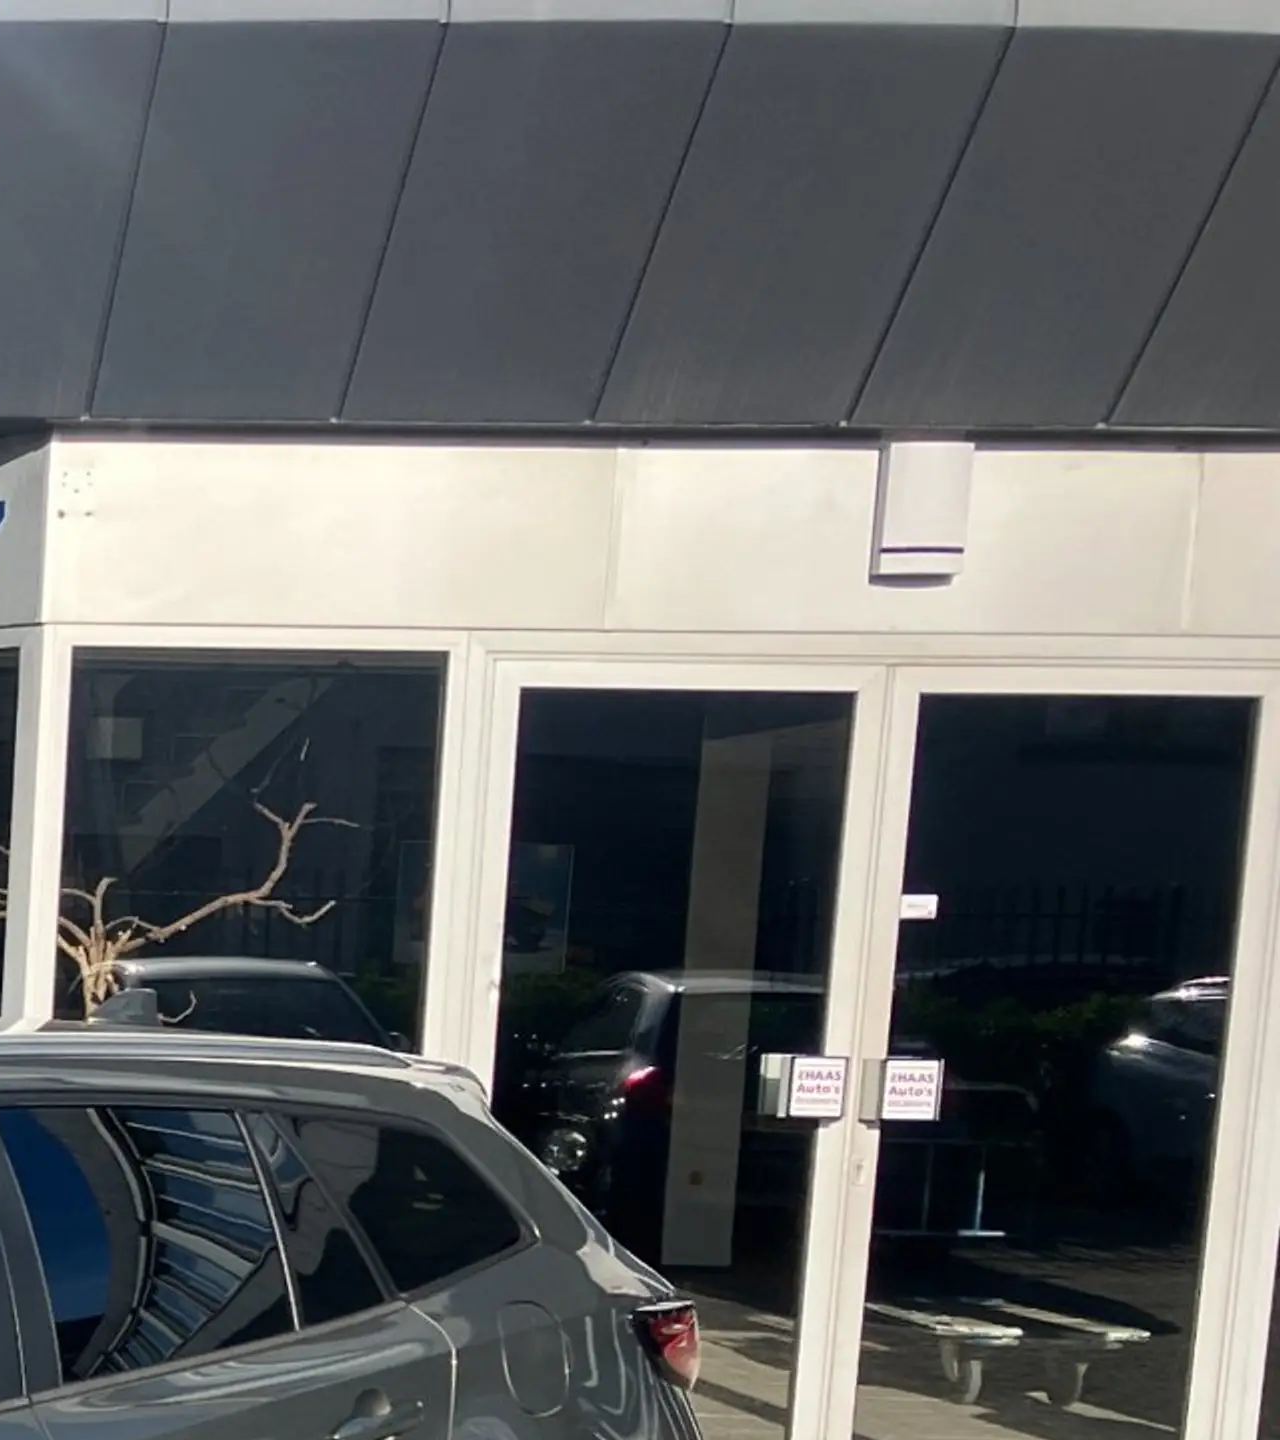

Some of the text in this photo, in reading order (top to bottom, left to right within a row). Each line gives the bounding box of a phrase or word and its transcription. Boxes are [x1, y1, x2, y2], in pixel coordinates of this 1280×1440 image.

[806, 1070, 842, 1082] HAAS
[897, 1072, 935, 1084] HAAS
[796, 1083, 840, 1095] Auto's
[888, 1086, 934, 1098] Auto's
